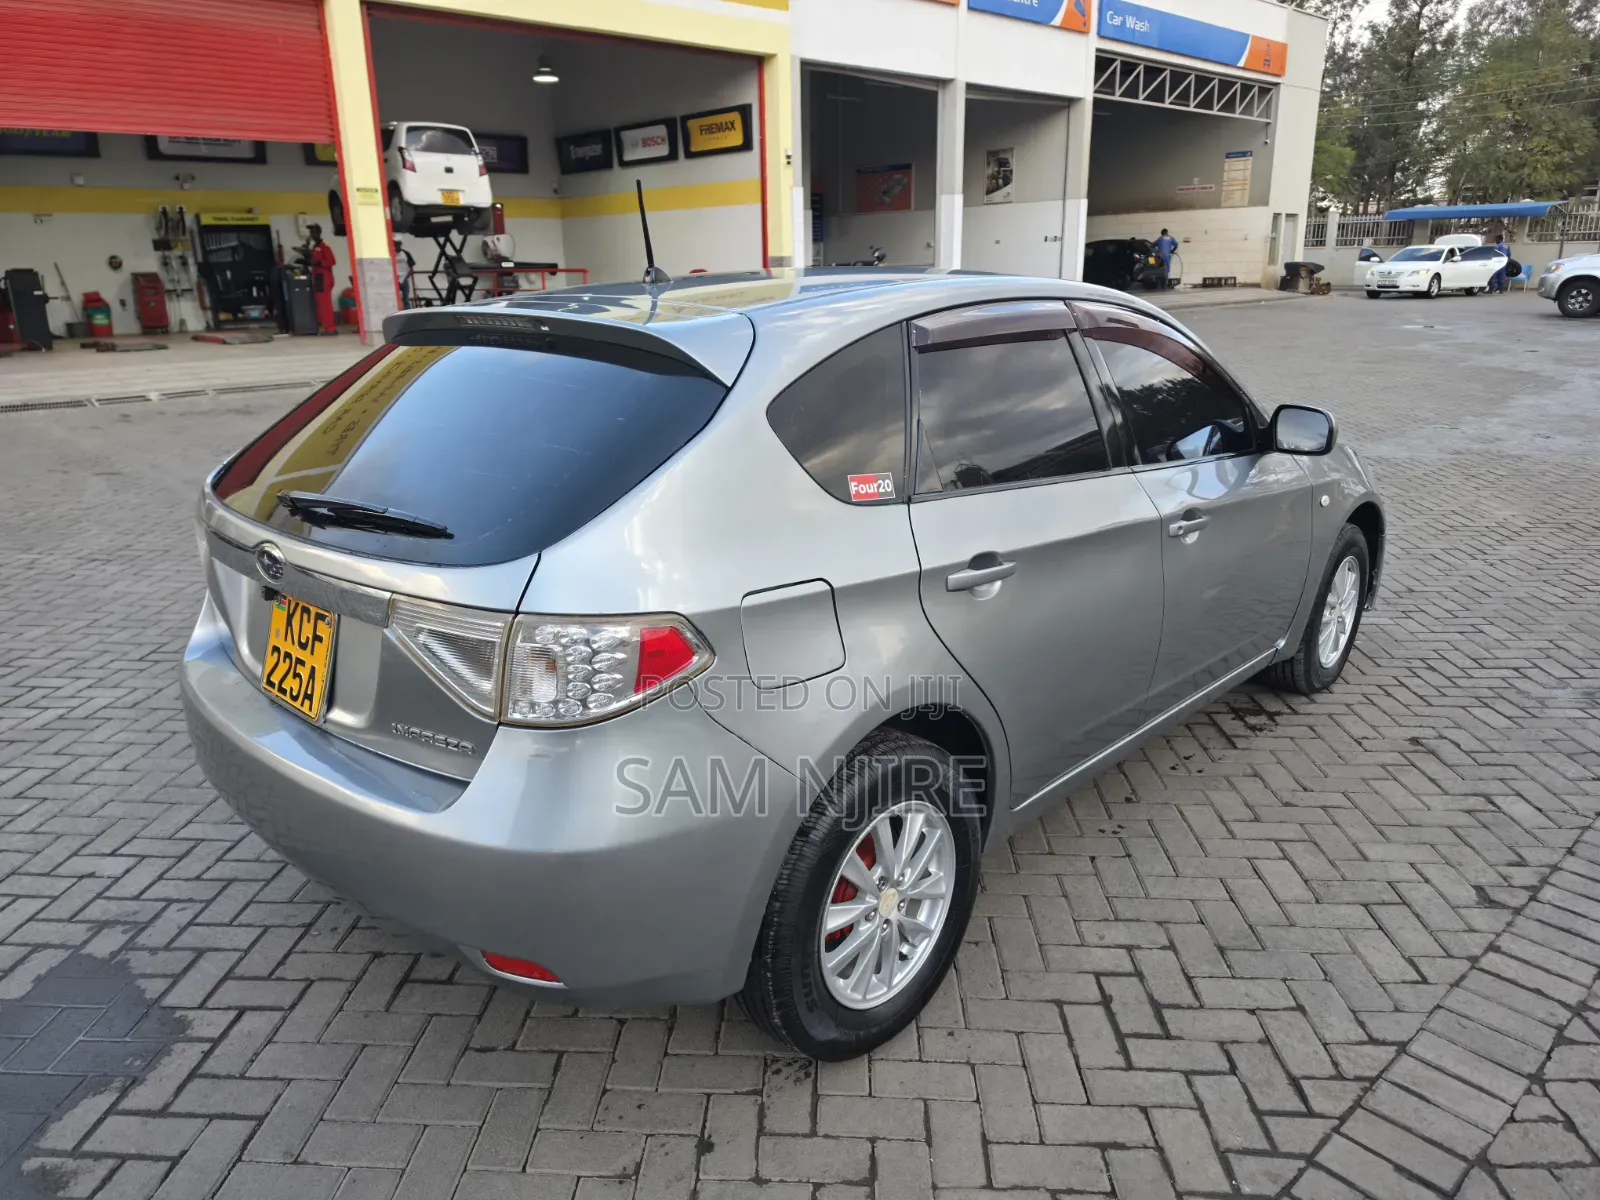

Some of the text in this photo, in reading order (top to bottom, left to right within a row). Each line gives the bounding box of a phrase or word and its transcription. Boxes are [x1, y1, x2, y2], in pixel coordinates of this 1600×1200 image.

[1106, 10, 1150, 33] Car Wash
[699, 120, 736, 136] FREMAX
[641, 136, 666, 148] BOSCH
[851, 480, 892, 494] Four20
[284, 597, 329, 656] KCF
[265, 645, 317, 713] 225A
